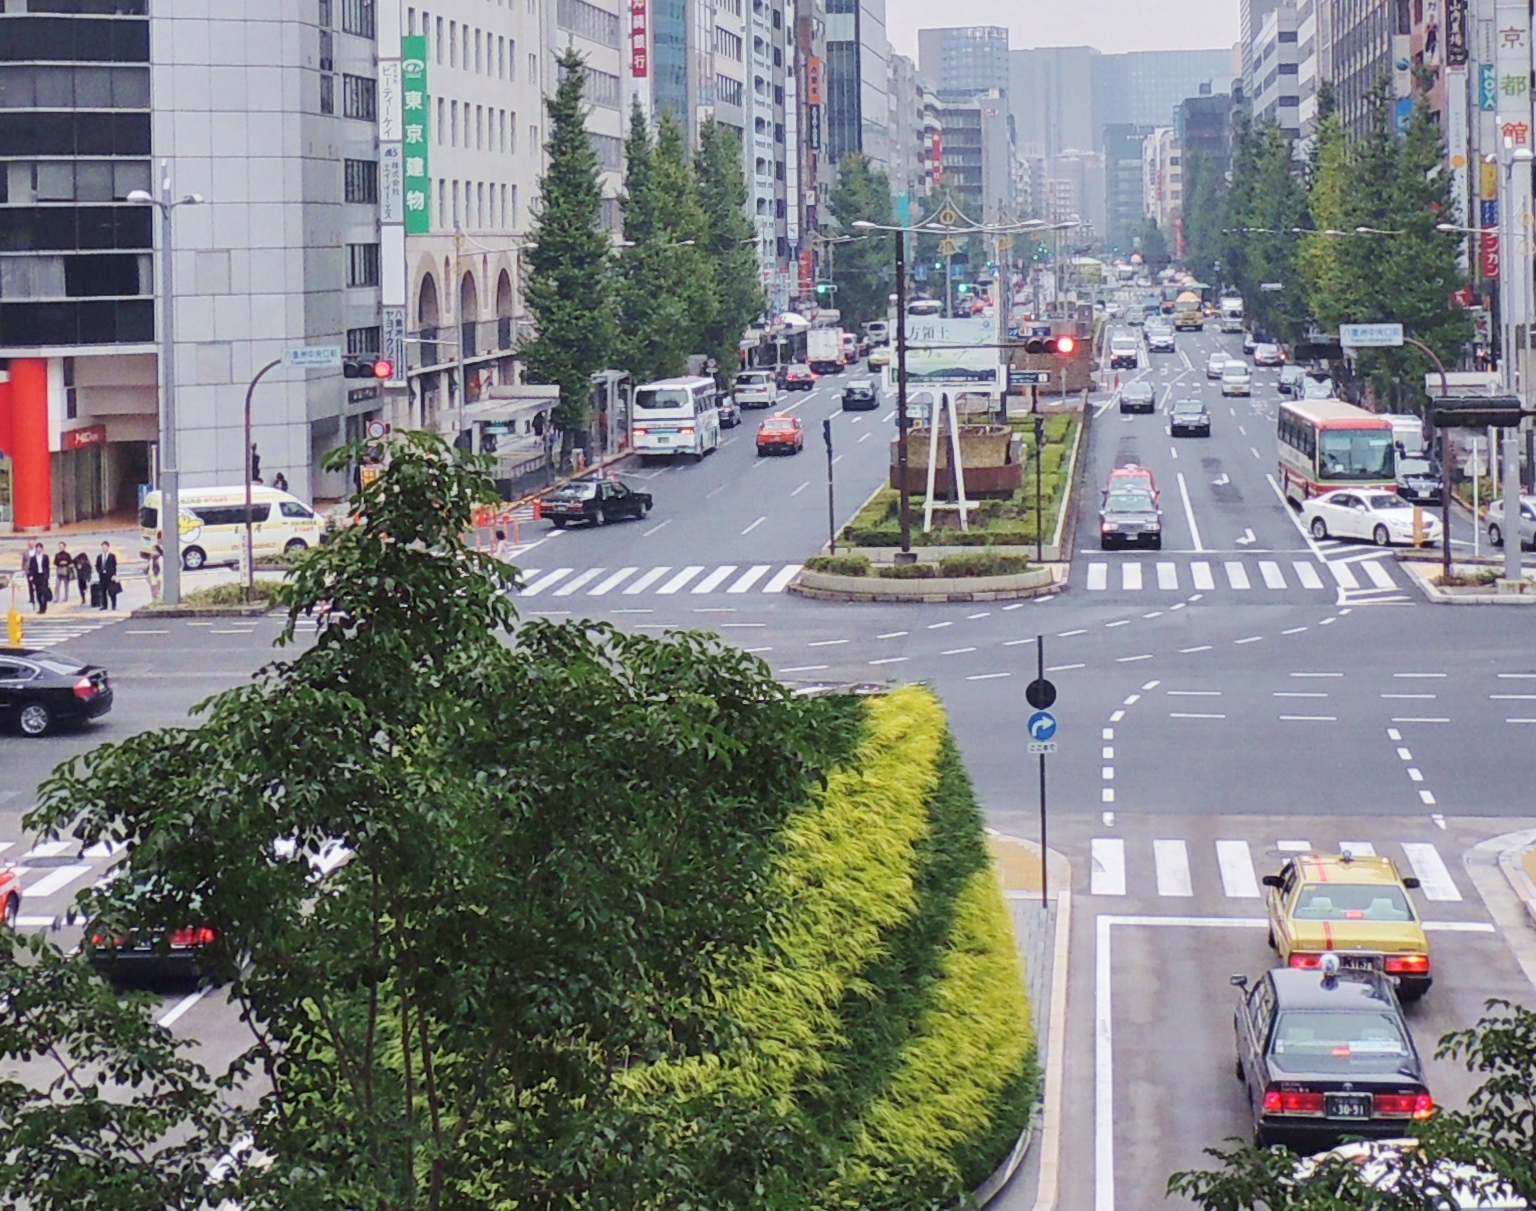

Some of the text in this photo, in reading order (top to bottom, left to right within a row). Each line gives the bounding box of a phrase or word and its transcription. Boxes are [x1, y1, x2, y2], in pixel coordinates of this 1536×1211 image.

[1484, 69, 1495, 108] NOVA
[1500, 25, 1528, 145] 京都館
[403, 90, 425, 211] 東京建物
[1338, 1103, 1364, 1116] 30-91
